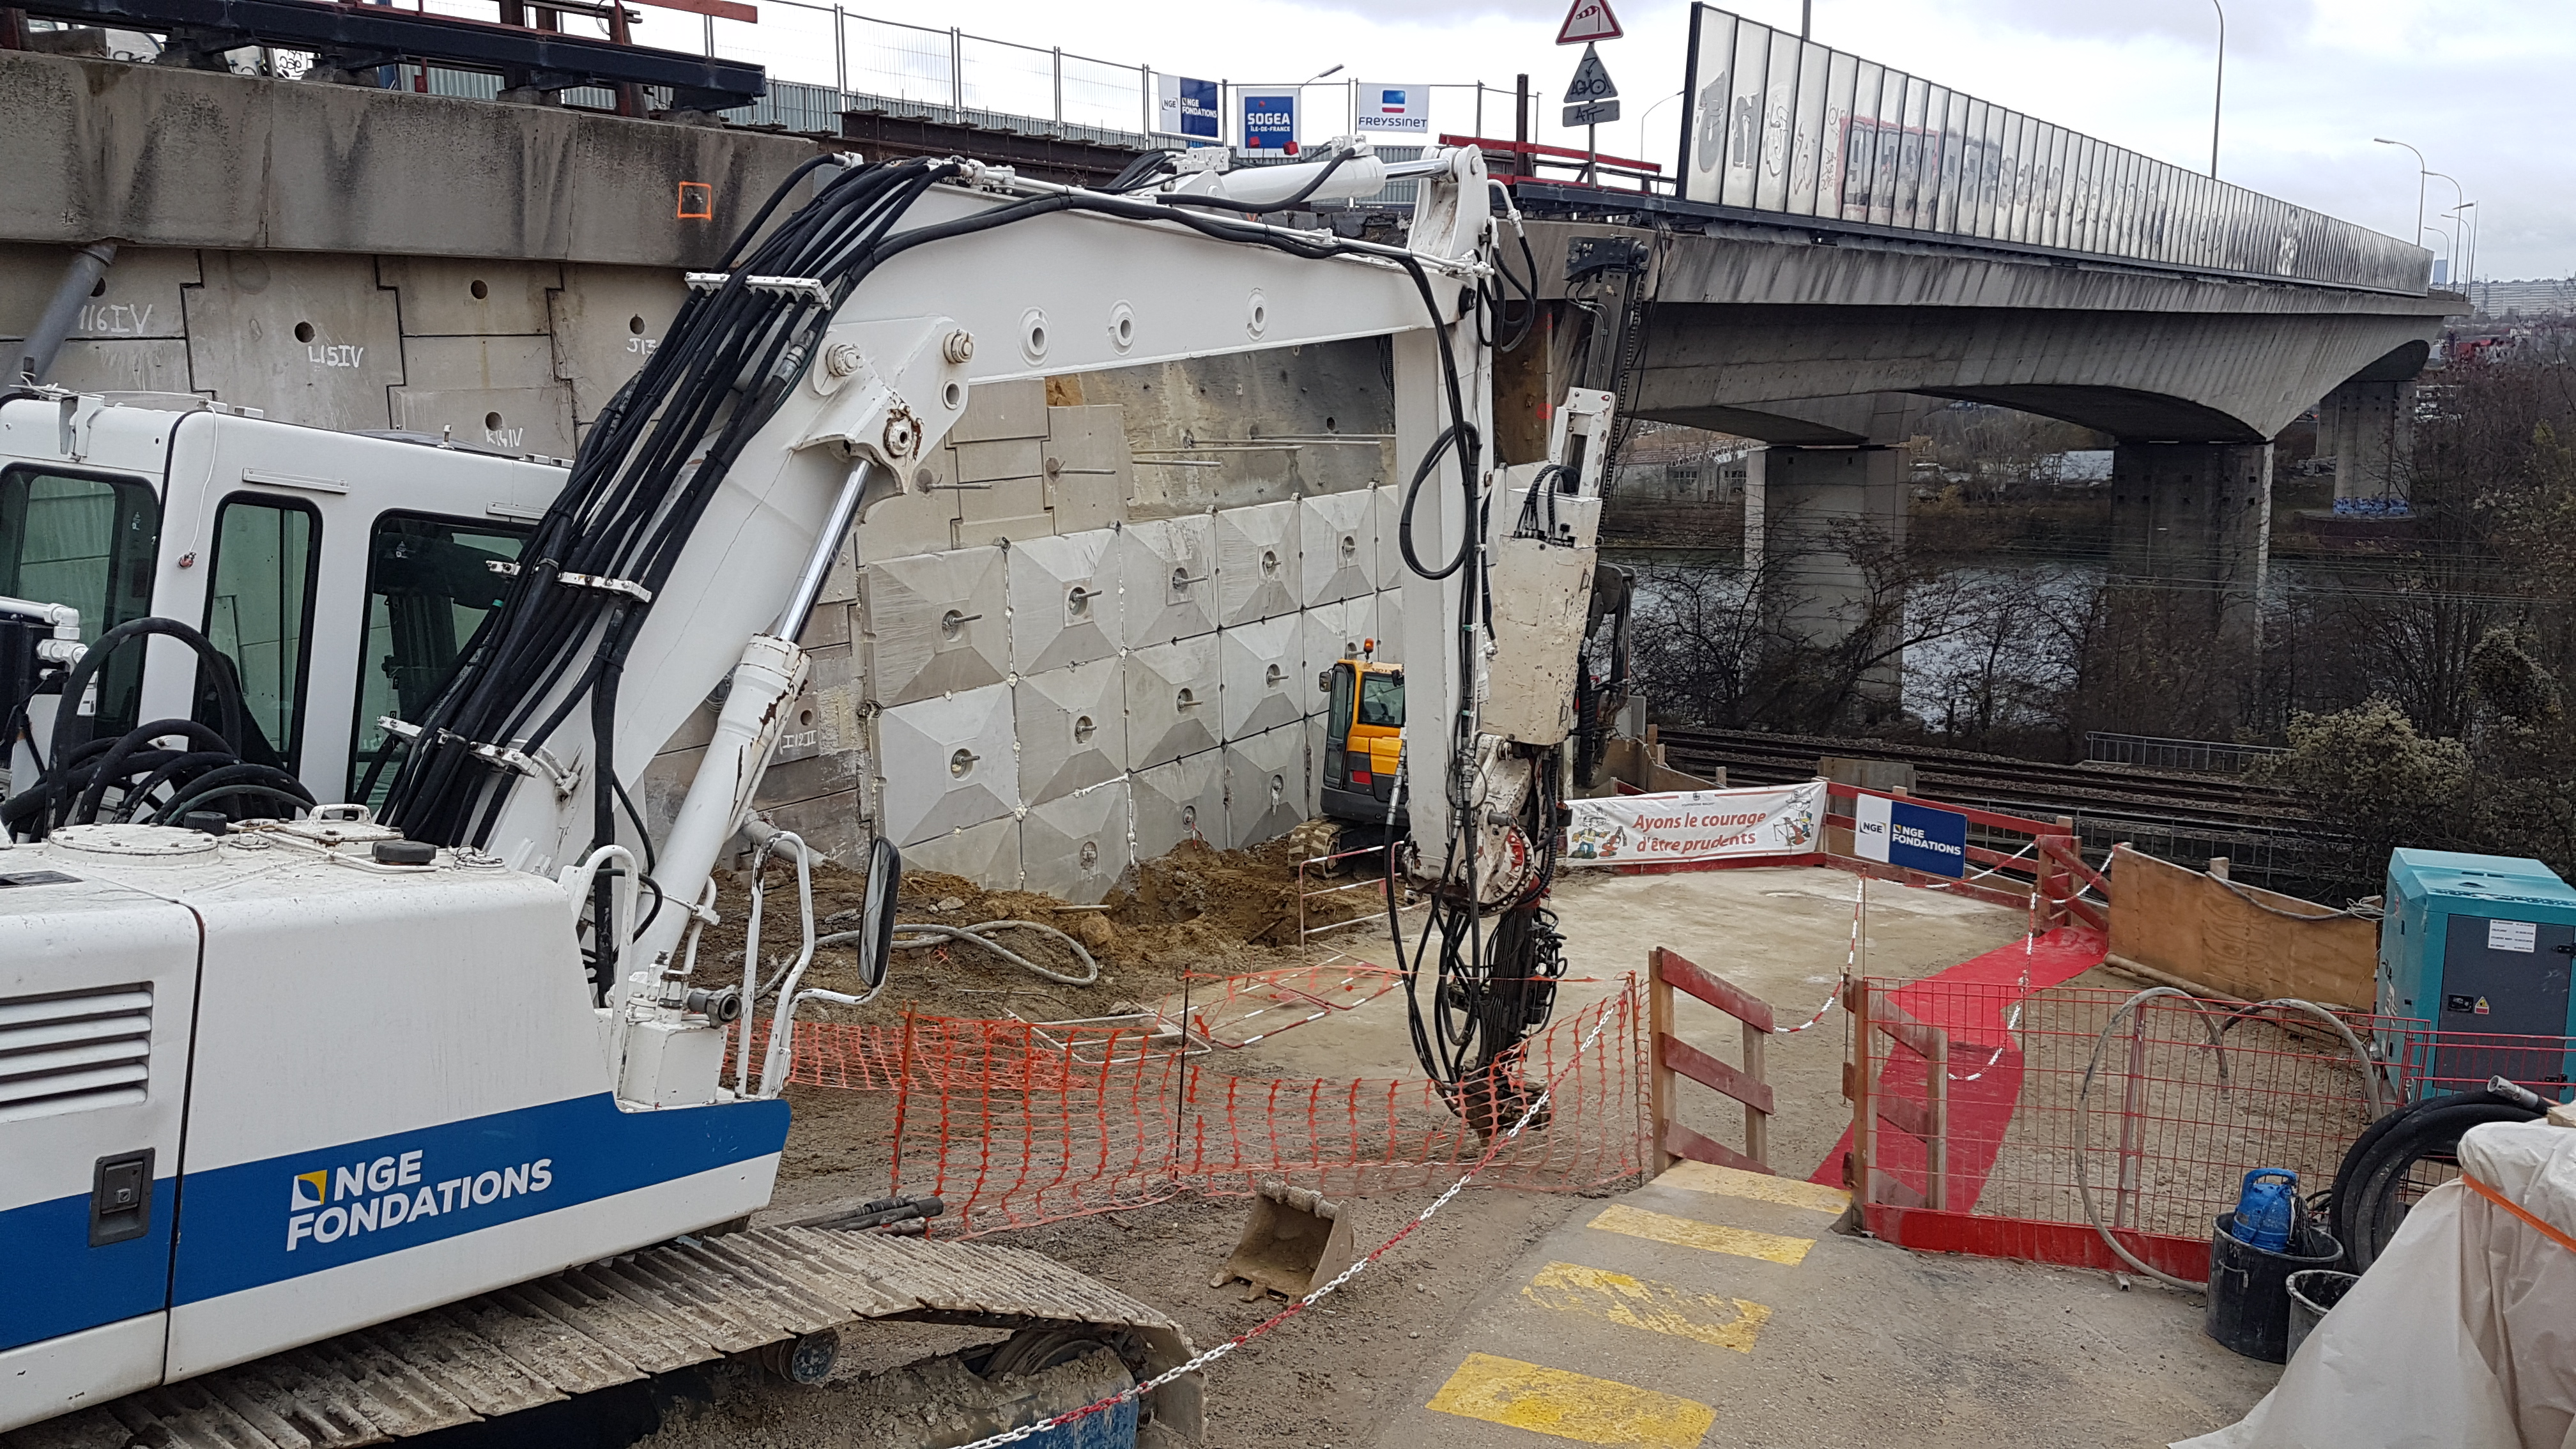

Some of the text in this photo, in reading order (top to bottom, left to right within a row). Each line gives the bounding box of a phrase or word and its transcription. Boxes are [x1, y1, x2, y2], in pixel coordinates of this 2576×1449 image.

[1164, 100, 1176, 108] NGE
[1187, 98, 1199, 107] NGE
[1182, 107, 1217, 118] FONDATIONS
[1248, 112, 1290, 125] SOGEA
[1632, 812, 1767, 832] Ayons le courage
[1863, 822, 1883, 833] NGE
[1902, 826, 1925, 838] NGE
[1637, 832, 1756, 854] d'être prudents
[1892, 833, 1961, 855] FONDATIONS
[334, 1149, 423, 1200] NGE
[286, 1158, 552, 1252] FONDATIONS
